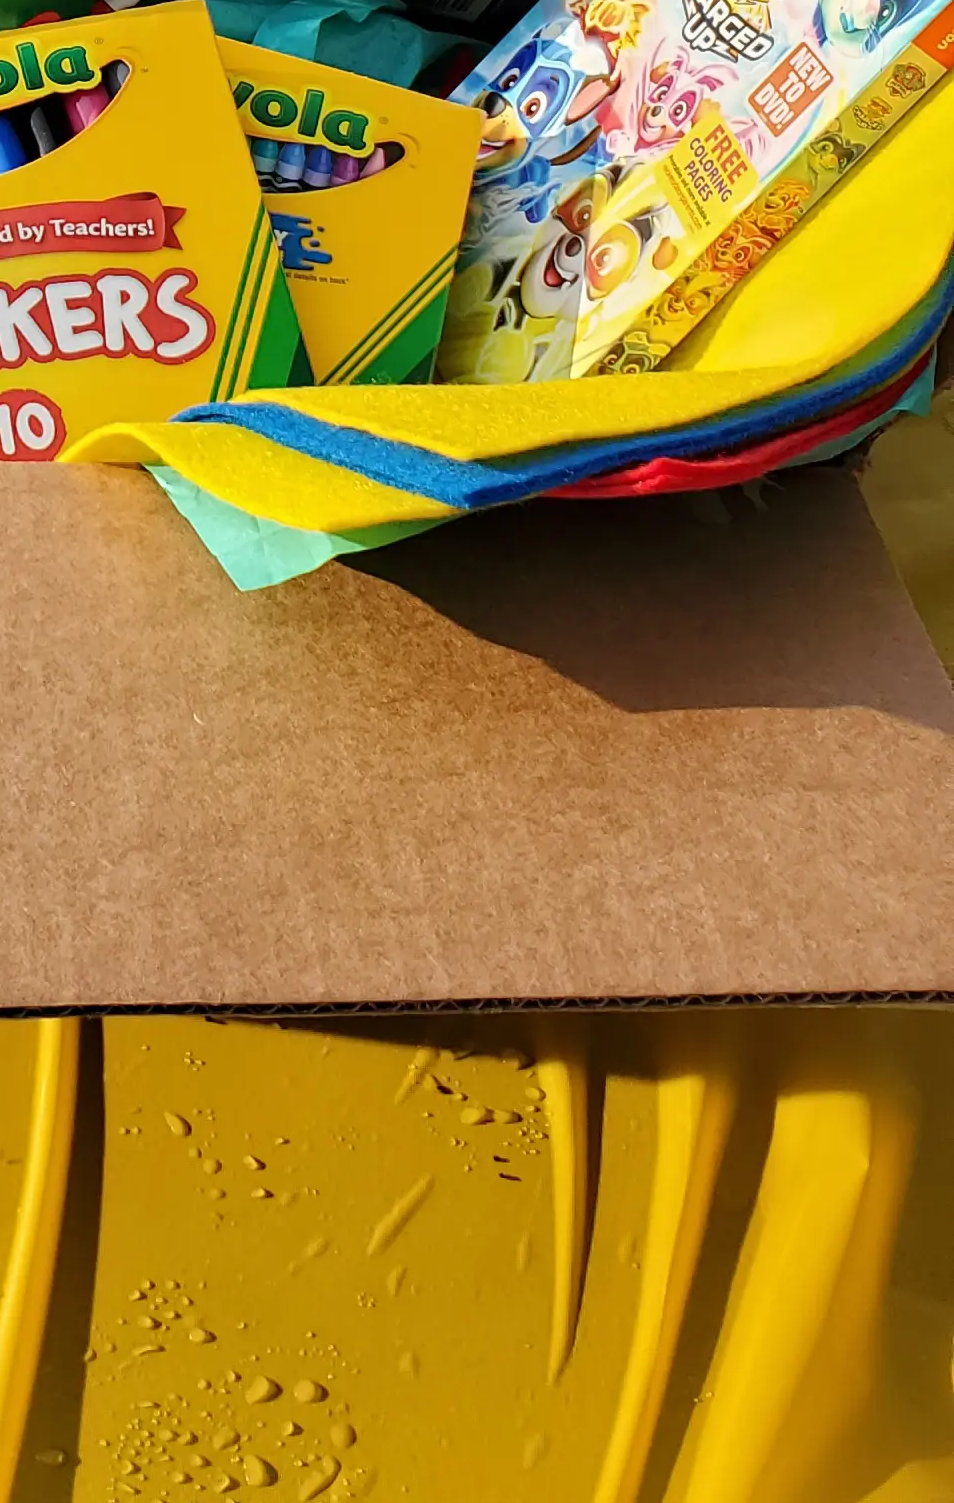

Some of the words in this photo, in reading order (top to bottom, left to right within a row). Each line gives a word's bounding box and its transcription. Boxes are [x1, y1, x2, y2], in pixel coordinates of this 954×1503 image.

[682, 14, 722, 57] UP
[780, 72, 806, 105] TO
[789, 44, 831, 91] NEW
[753, 82, 795, 130] DVD!
[689, 137, 733, 204] COLORING
[704, 123, 748, 185] FREE
[683, 157, 714, 203] PAGES
[17, 219, 45, 244] by
[48, 217, 156, 238] Teachers!
